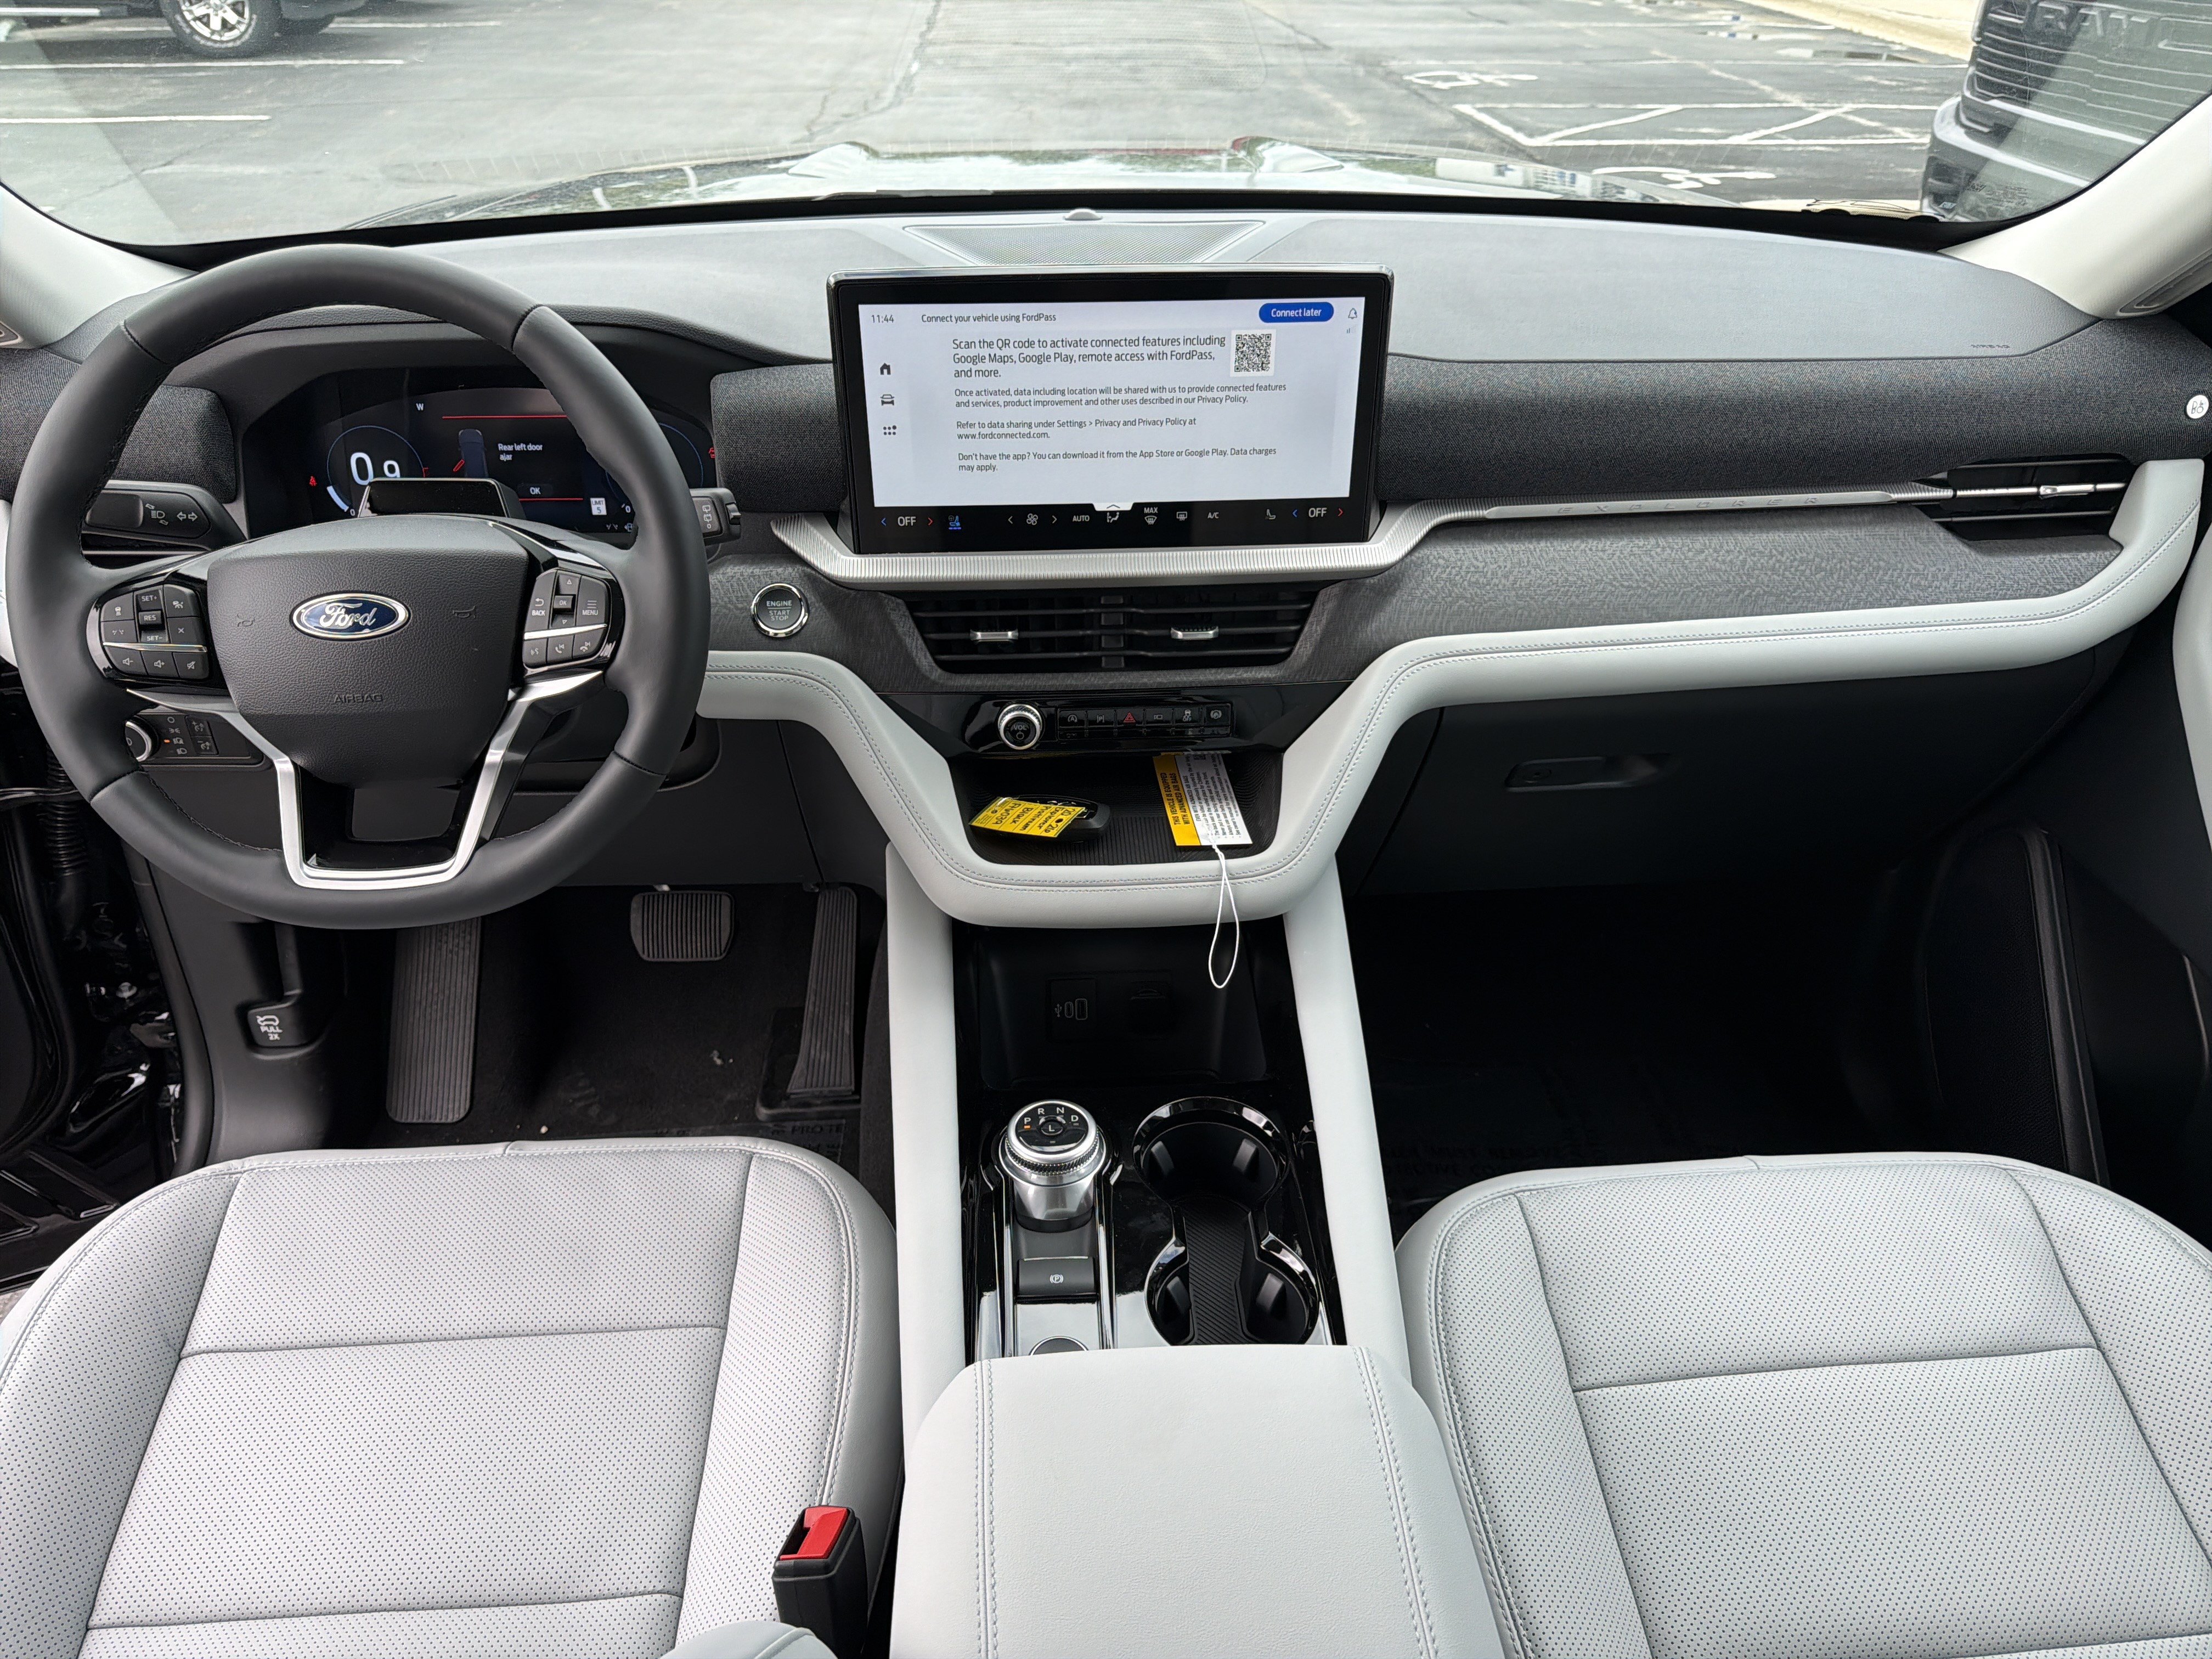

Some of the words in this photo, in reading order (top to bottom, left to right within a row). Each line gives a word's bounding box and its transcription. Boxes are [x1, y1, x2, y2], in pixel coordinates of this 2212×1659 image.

[870, 313, 895, 324] 11:44
[920, 313, 953, 323] Connect
[953, 314, 972, 324] your
[972, 312, 1000, 323] vehicle
[999, 312, 1021, 324] using
[1021, 312, 1057, 322] FordPass
[1271, 307, 1302, 318] Connect
[1302, 307, 1322, 317] later
[951, 337, 977, 350] Scan
[977, 337, 995, 350] the
[995, 337, 1011, 352] QR
[1012, 337, 1036, 351] code
[1036, 337, 1048, 349] to
[1048, 336, 1089, 349] activate
[1090, 335, 1140, 348] connected
[1140, 334, 1181, 347] features
[1182, 334, 1226, 348] including
[952, 352, 987, 366] Google
[988, 352, 1017, 366] Maps,
[1018, 351, 1052, 365] Google
[1053, 351, 1077, 365] Play,
[1077, 351, 1113, 363] remote
[1114, 351, 1146, 362] access
[1146, 349, 1169, 362] with
[1169, 348, 1216, 362] FordPass,
[953, 366, 973, 379] and
[974, 368, 1002, 378] more.
[953, 387, 974, 397] Once
[974, 387, 1013, 398] activated,
[1013, 387, 1032, 397] data
[1032, 386, 1066, 398] including
[1066, 386, 1097, 396] location
[1098, 385, 1112, 395] will
[1112, 385, 1123, 395] be
[1123, 385, 1149, 395] shared
[1149, 384, 1167, 394] with
[1177, 384, 1187, 393] to
[1187, 383, 1215, 395] provide
[1215, 382, 1255, 393] connected
[1255, 382, 1287, 392] features
[415, 403, 424, 411] W
[955, 398, 970, 408] and
[970, 398, 1003, 409] services,
[1002, 397, 1032, 409] product
[1032, 397, 1084, 408] improvement
[1084, 396, 1099, 406] and
[1099, 396, 1120, 406] other
[1138, 394, 1175, 405] described
[1175, 395, 1183, 405] in
[1183, 395, 1197, 404] our
[1197, 393, 1224, 405] Privacy
[1224, 393, 1249, 405] Policy.
[956, 420, 977, 430] Refer
[977, 420, 986, 430] to
[986, 419, 1005, 429] data
[1005, 419, 1034, 430] sharing
[1033, 419, 1056, 428] under
[1056, 418, 1087, 430] Settings
[1094, 417, 1121, 429] Privacy
[1121, 417, 1137, 427] and
[1137, 417, 1164, 428] Privacy
[1165, 416, 1188, 427] Policy
[1187, 416, 1197, 426] at
[956, 429, 1051, 441] www.fordconnected.com.
[498, 443, 514, 452] Rear
[514, 442, 527, 452] left
[527, 442, 543, 451] door
[499, 453, 513, 462] ajar
[957, 452, 979, 461] Don't
[978, 452, 997, 461] have
[997, 451, 1012, 461] the
[1011, 451, 1031, 462] app?
[1031, 451, 1047, 460] You
[1061, 450, 1099, 460] download
[1099, 450, 1105, 459] it
[1105, 449, 1124, 459] from
[1124, 449, 1138, 459] the
[1138, 449, 1154, 460] App
[1154, 448, 1175, 458] Store
[1184, 448, 1210, 459] Google
[1210, 447, 1229, 458] Play.
[1229, 447, 1248, 456] Data
[1248, 445, 1277, 457] charges
[350, 452, 374, 486] 0
[957, 464, 975, 473] may
[975, 462, 998, 473] apply.
[529, 487, 541, 495] OK
[596, 506, 602, 515] 5
[1557, 496, 1818, 515] EXPLORER
[1207, 511, 1220, 520] A/C
[1308, 507, 1328, 518] OFF
[897, 516, 917, 527] OFF
[319, 602, 379, 629] Ford
[334, 693, 384, 704] AIRBAG
[1160, 772, 1172, 792] EQUIPPED
[1169, 772, 1178, 783] BAGS
[1166, 798, 1178, 815] VEHICLE
[1174, 792, 1187, 813] ADVANCED
[1010, 807, 1033, 825] Black
[1019, 805, 1049, 831] Platinum
[1037, 806, 1060, 830] Explorer
[1171, 816, 1181, 825] THIS
[1181, 814, 1190, 824] WITH
